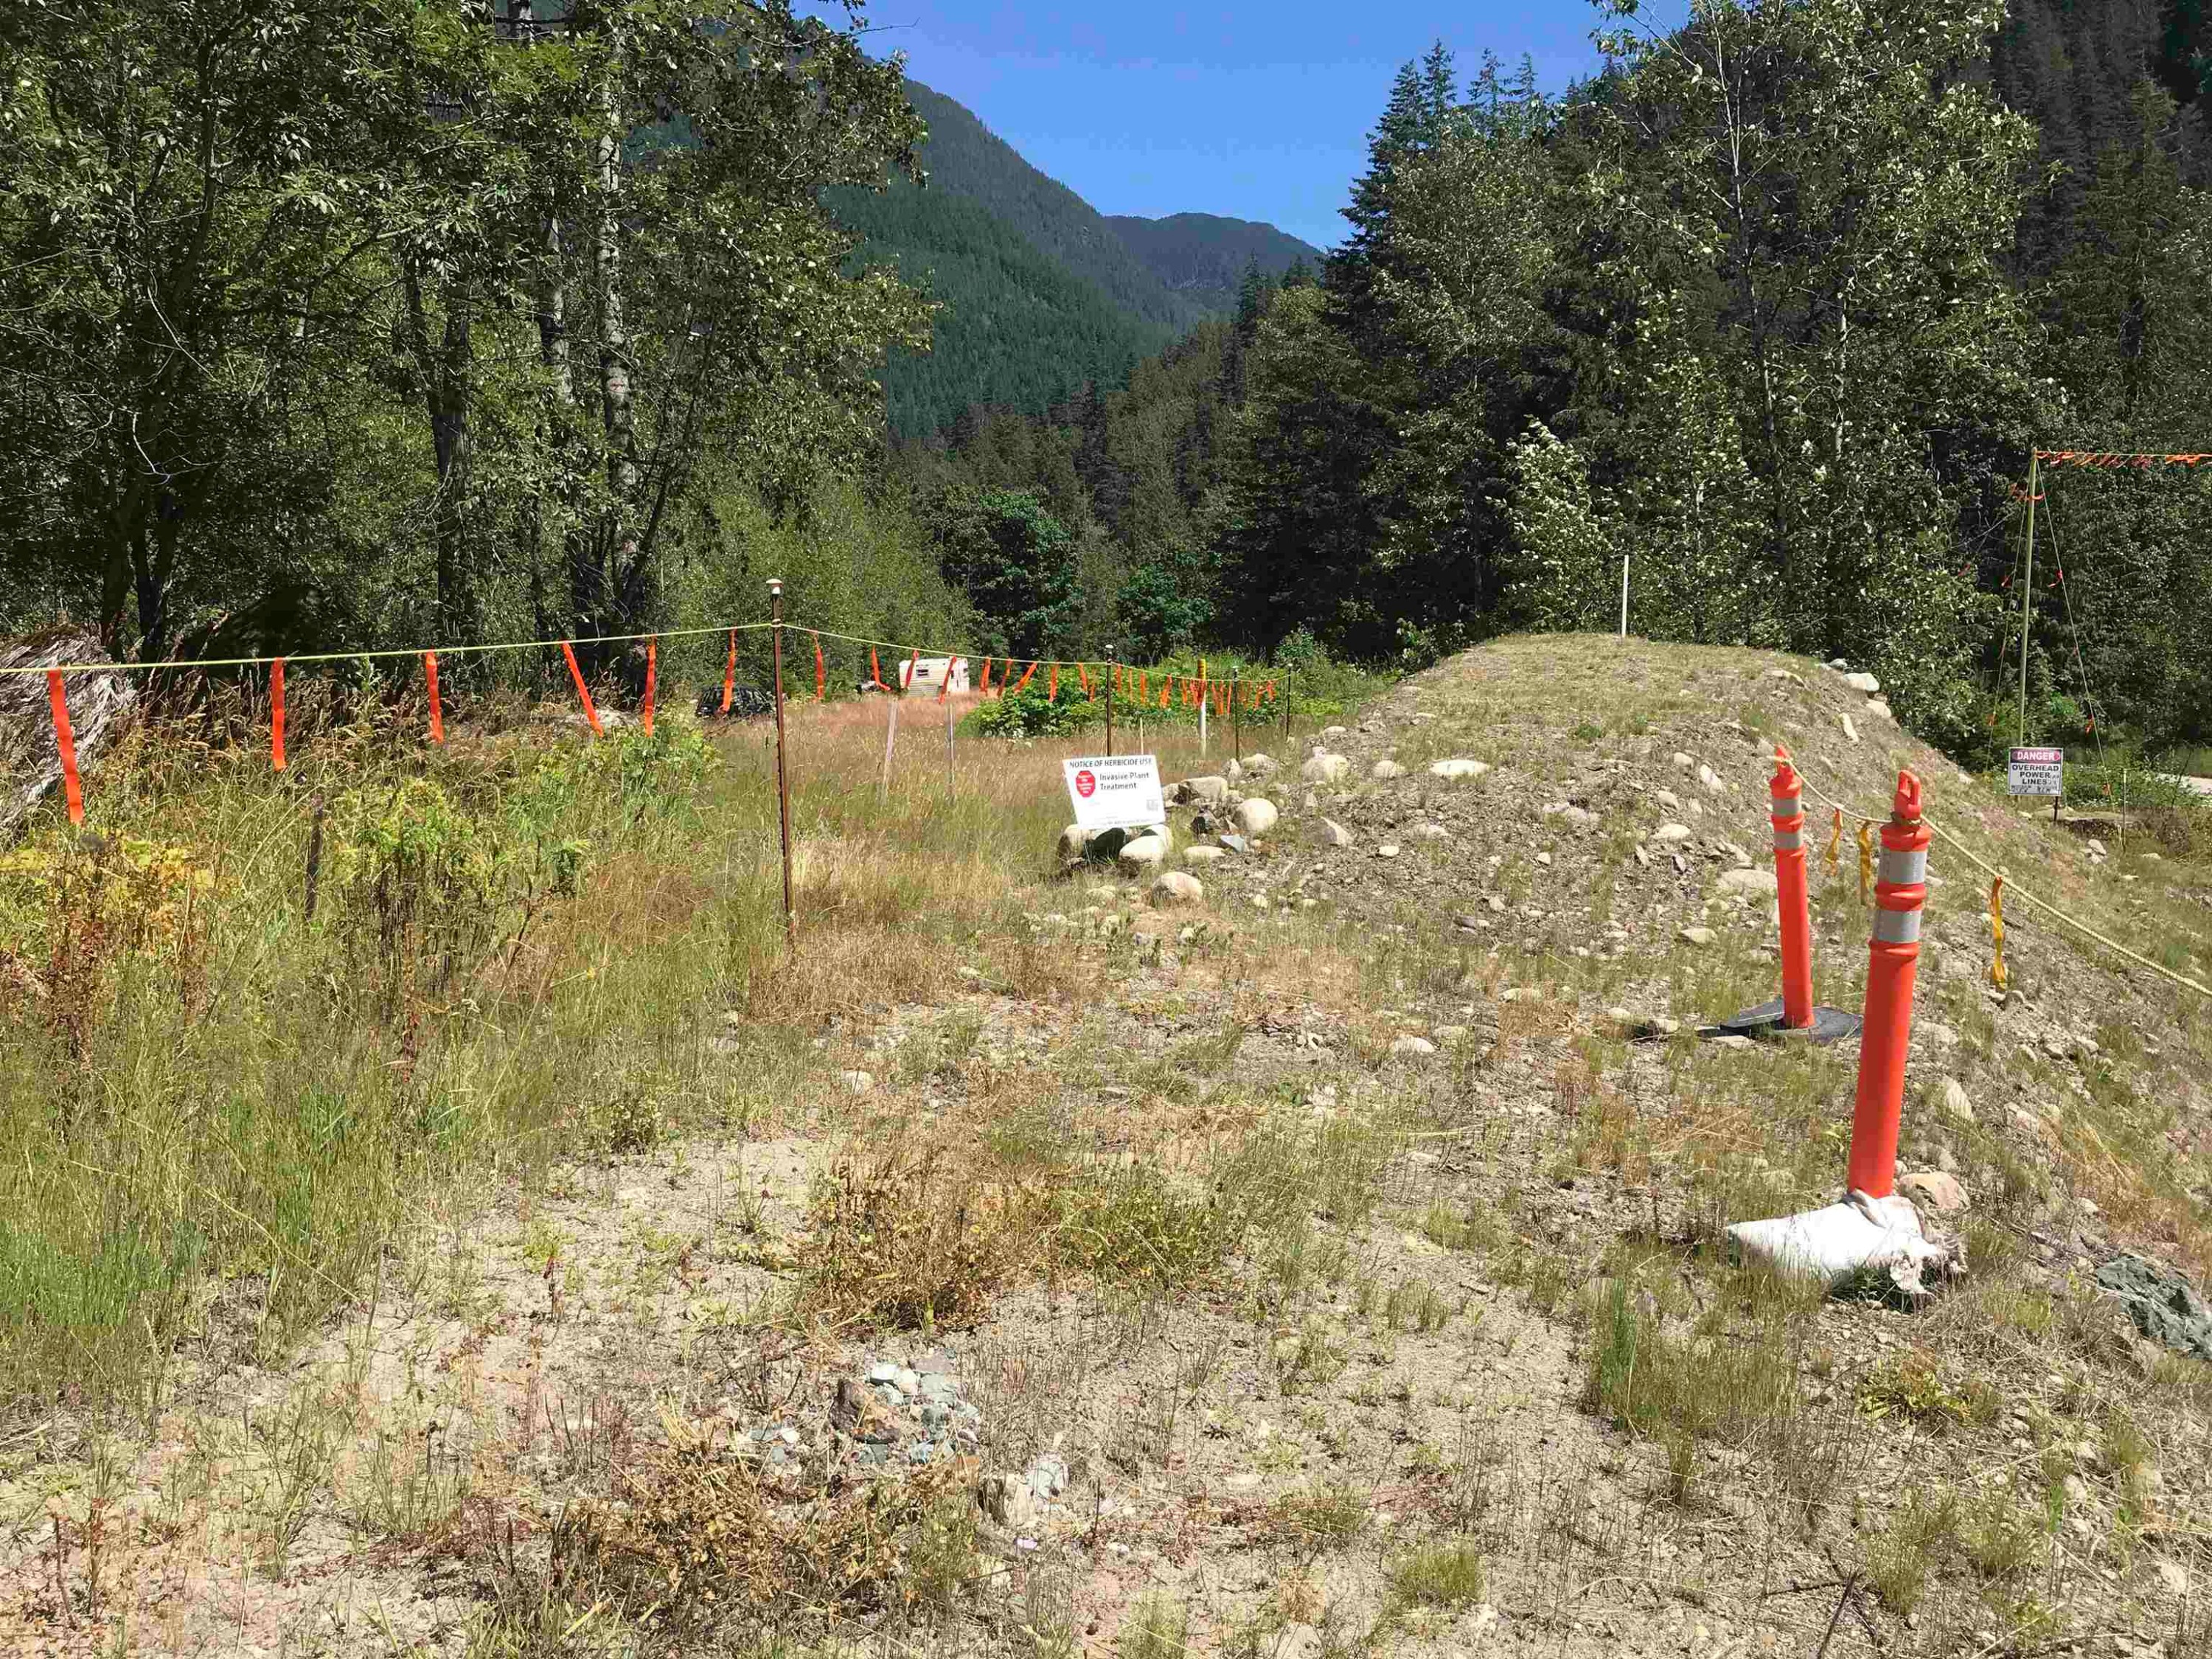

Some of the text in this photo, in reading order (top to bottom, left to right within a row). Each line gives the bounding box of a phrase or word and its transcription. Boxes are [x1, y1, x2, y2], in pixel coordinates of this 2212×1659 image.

[2017, 751, 2054, 761] DANGER
[1070, 759, 1093, 768] NOTICE
[1094, 759, 1102, 767] OF
[1105, 758, 1138, 766] HERBICIDE
[1099, 771, 1150, 781] Invasive Plant
[1099, 782, 1137, 790] Treatment
